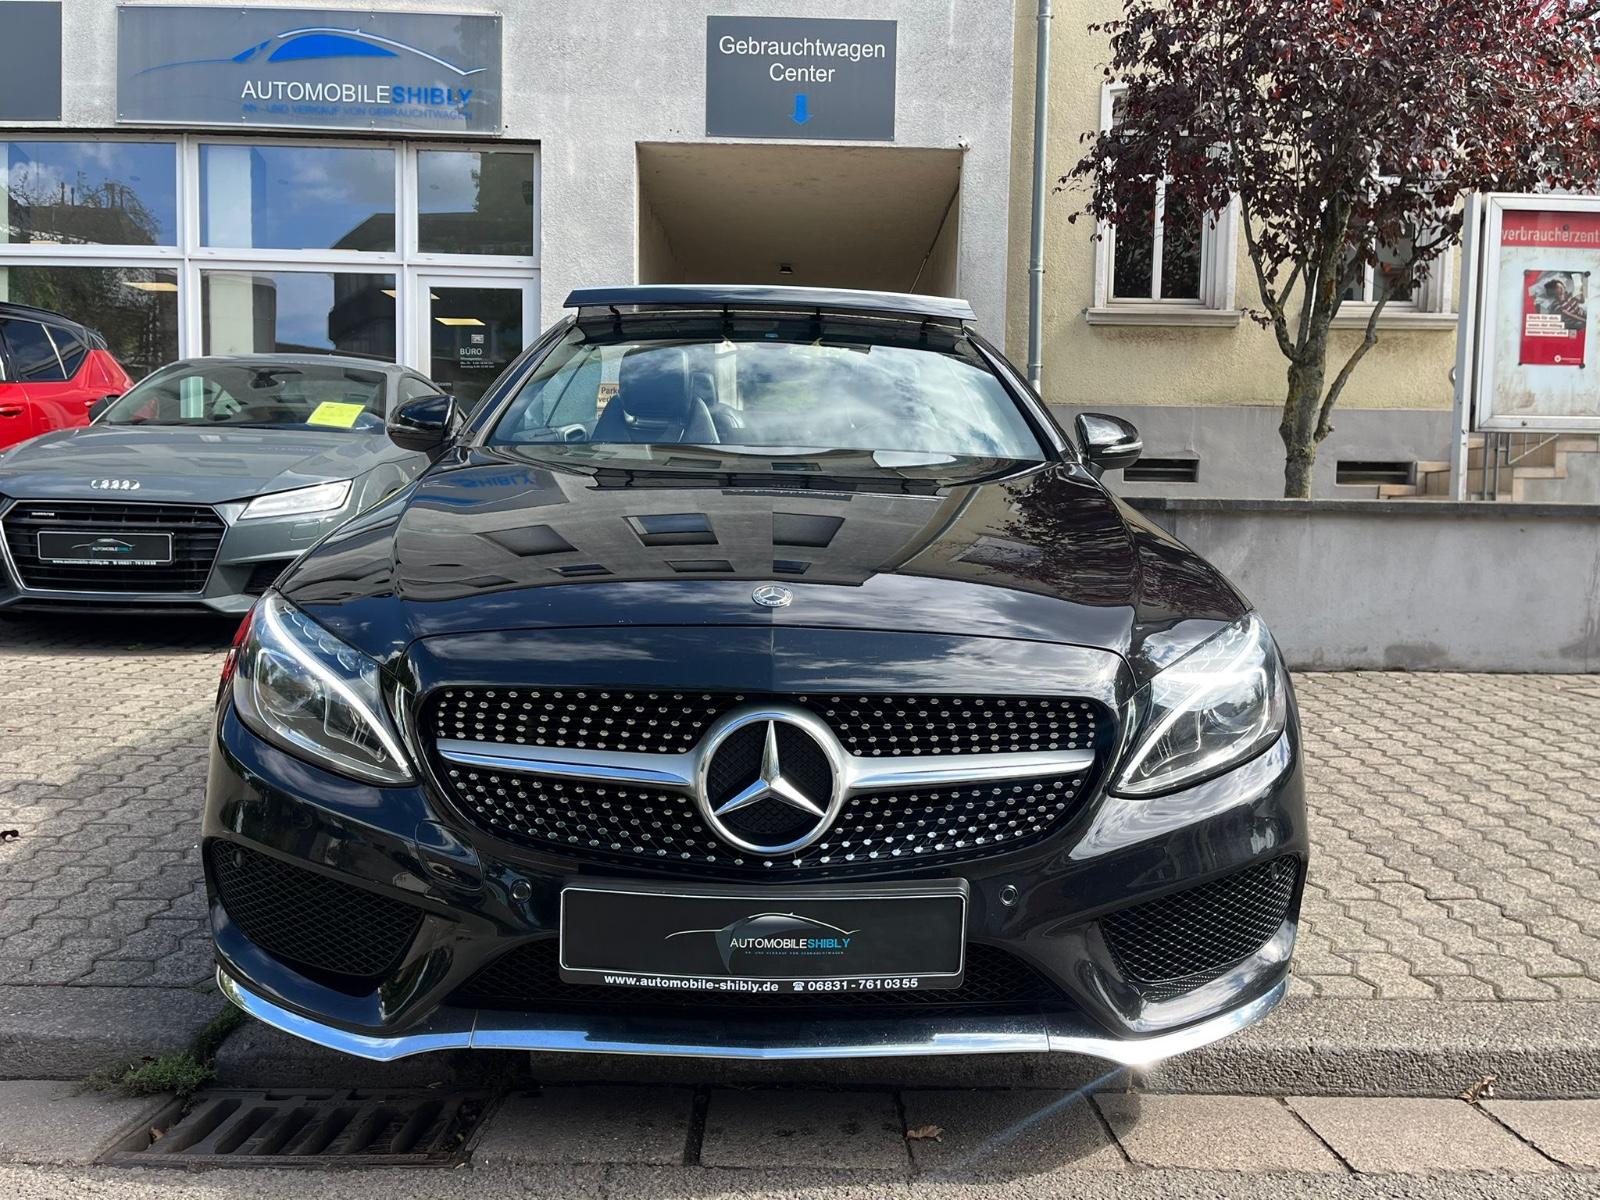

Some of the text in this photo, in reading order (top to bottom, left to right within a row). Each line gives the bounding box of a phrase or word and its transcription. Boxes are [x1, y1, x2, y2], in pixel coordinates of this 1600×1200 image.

[719, 36, 886, 62] Gebrauchtwagen
[769, 63, 836, 82] Center
[241, 80, 473, 107] AUTOMOBILESHIBLY
[293, 104, 338, 116] VERKAUF
[343, 106, 366, 116] VON
[1502, 226, 1600, 243] verbraucherzent
[459, 346, 483, 355] BÜRO
[730, 938, 850, 949] AUTOMOBILESHIBLY
[604, 974, 779, 993] www.automobile-shibly.de
[807, 980, 848, 991] 06831
